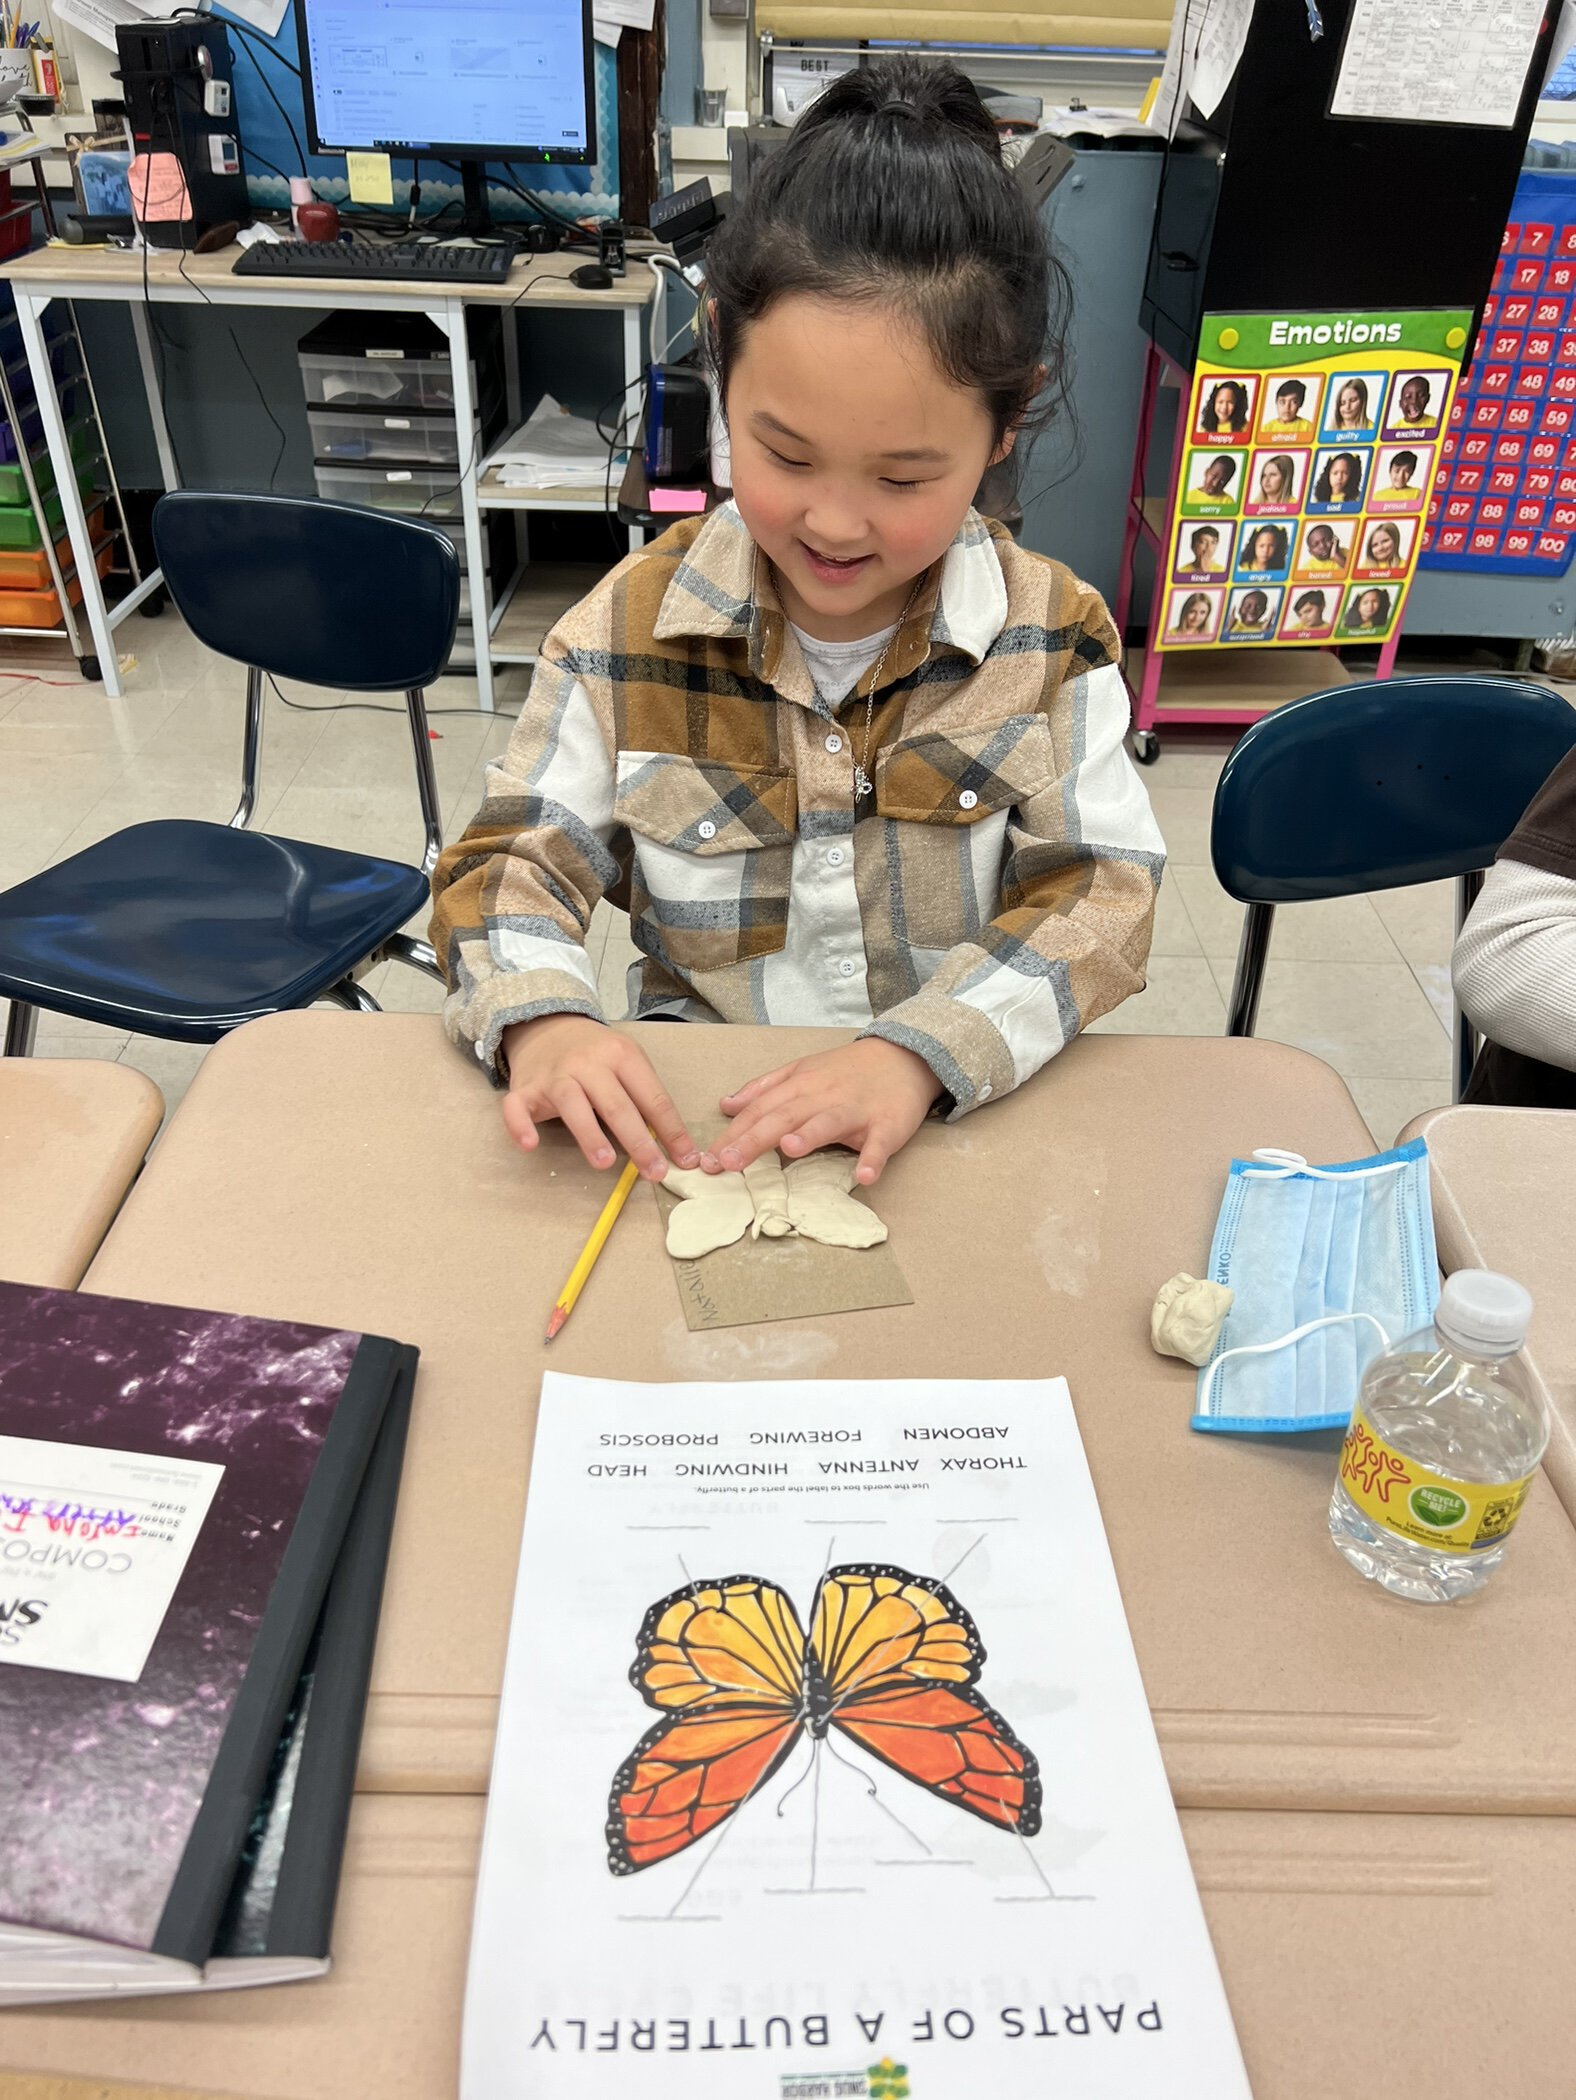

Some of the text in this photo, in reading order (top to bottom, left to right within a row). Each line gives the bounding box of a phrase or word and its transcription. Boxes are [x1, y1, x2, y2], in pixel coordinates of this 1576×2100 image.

[1532, 232, 1543, 246] 7
[1521, 269, 1569, 284] 17 18
[1506, 304, 1527, 319] 27
[1538, 305, 1559, 320] 28
[1269, 320, 1402, 345] Emotions
[1497, 338, 1517, 353] 37
[1529, 340, 1549, 355] 38
[1486, 373, 1576, 391] 47 48 49
[1451, 406, 1567, 426] 6 57 58 59
[1208, 433, 1234, 444] happy
[1336, 432, 1359, 442] guilty
[1395, 429, 1425, 439] excited
[1444, 439, 1454, 453] 6
[1466, 441, 1486, 454] 67
[1500, 442, 1520, 456] 68
[1534, 443, 1554, 458] 69
[1436, 470, 1447, 484] 6
[1459, 471, 1479, 485] 77
[1495, 472, 1514, 487] 78
[1529, 474, 1549, 489] 79
[1450, 502, 1470, 516] 87
[1483, 504, 1503, 518] 88
[1519, 506, 1539, 520] 89
[1555, 510, 1576, 524] 90
[1443, 532, 1462, 546] 97
[1475, 534, 1494, 548] 98
[1508, 536, 1528, 550] 99
[1539, 538, 1565, 553] 100
[1249, 573, 1271, 582] angry
[599, 1426, 1009, 1446] ABDOMEN FOREWING PROBOSCIS
[587, 1456, 1028, 1477] THORAX ANTENNA HINDWING HEAD
[1420, 1488, 1461, 1508] RECYCLE
[1428, 1501, 1448, 1512] ME!
[151, 1501, 187, 1514] Grade
[138, 1514, 182, 1528] School
[140, 1529, 175, 1542] Name
[0, 1537, 133, 1575] COMPO
[530, 2002, 1162, 2051] PARTS OF A BUTTERFLY
